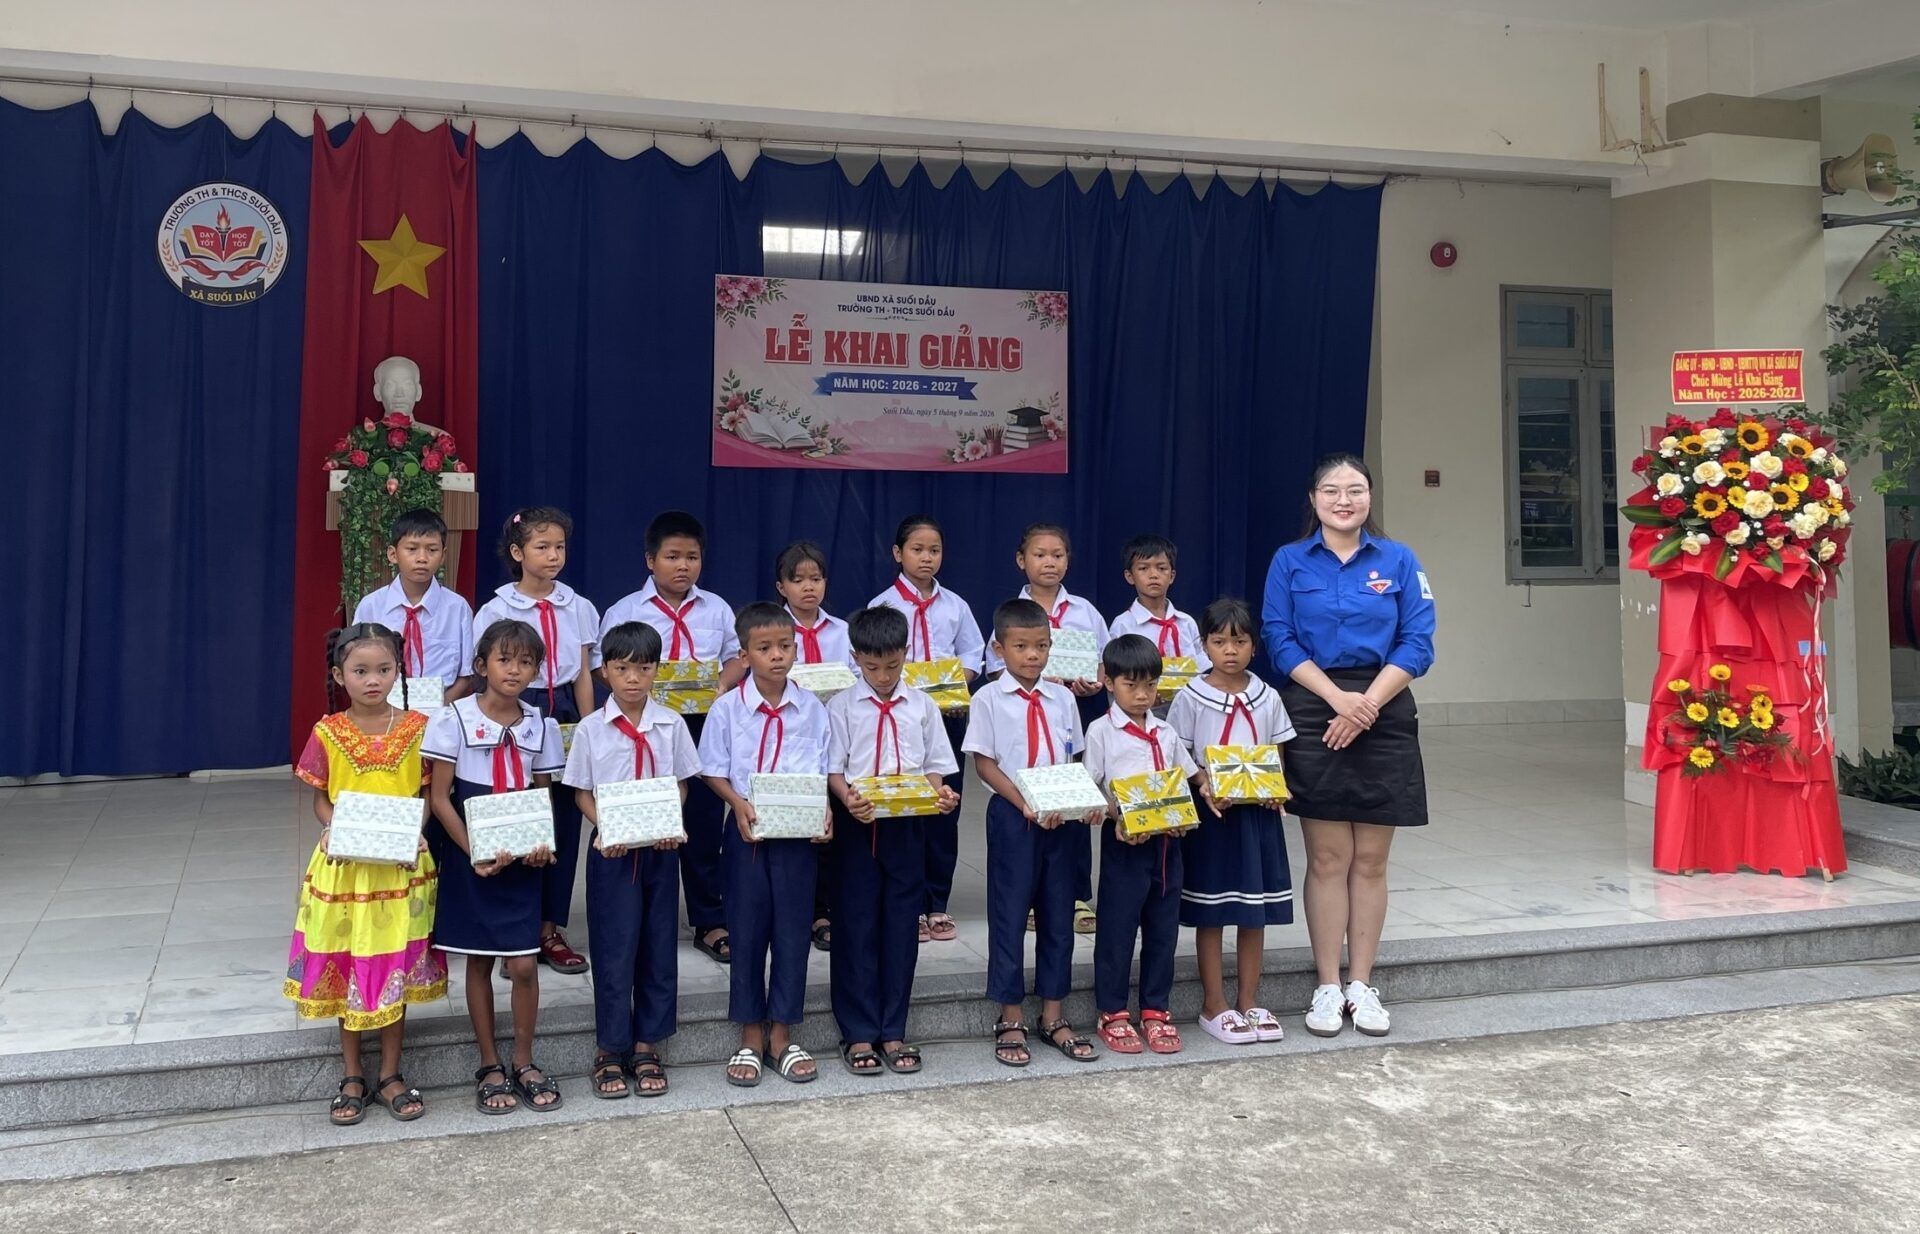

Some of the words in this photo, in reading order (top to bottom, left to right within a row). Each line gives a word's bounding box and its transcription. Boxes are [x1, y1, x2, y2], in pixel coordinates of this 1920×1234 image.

[195, 187, 209, 200] TH
[211, 187, 219, 196] &
[221, 187, 248, 201] THCS
[207, 290, 233, 302] SUỐI
[856, 295, 880, 303] UBND
[882, 295, 894, 304] XÃ
[896, 294, 917, 305] SUỐI
[837, 303, 873, 313] TRƯỜNG
[874, 306, 885, 314] TH
[892, 306, 913, 315] THCS
[915, 305, 935, 316] SUỐI
[764, 313, 811, 364] LỄ
[823, 329, 909, 368] KHAI
[918, 324, 1023, 372] GIẢNG
[833, 376, 859, 389] NĂM
[862, 378, 889, 391] HỌC:
[892, 379, 920, 391] 2026
[930, 381, 958, 392] 2027
[1691, 373, 1710, 387] Chúc
[1712, 372, 1732, 388] Mừng
[1734, 370, 1744, 386] Lễ
[1746, 372, 1761, 386] Khai
[1763, 370, 1784, 388] Giảng
[1678, 388, 1703, 400] Năm
[1706, 388, 1728, 402] Học
[1738, 386, 1797, 400] 2026-2027
[933, 408, 938, 416] 5
[938, 408, 957, 418] tháng
